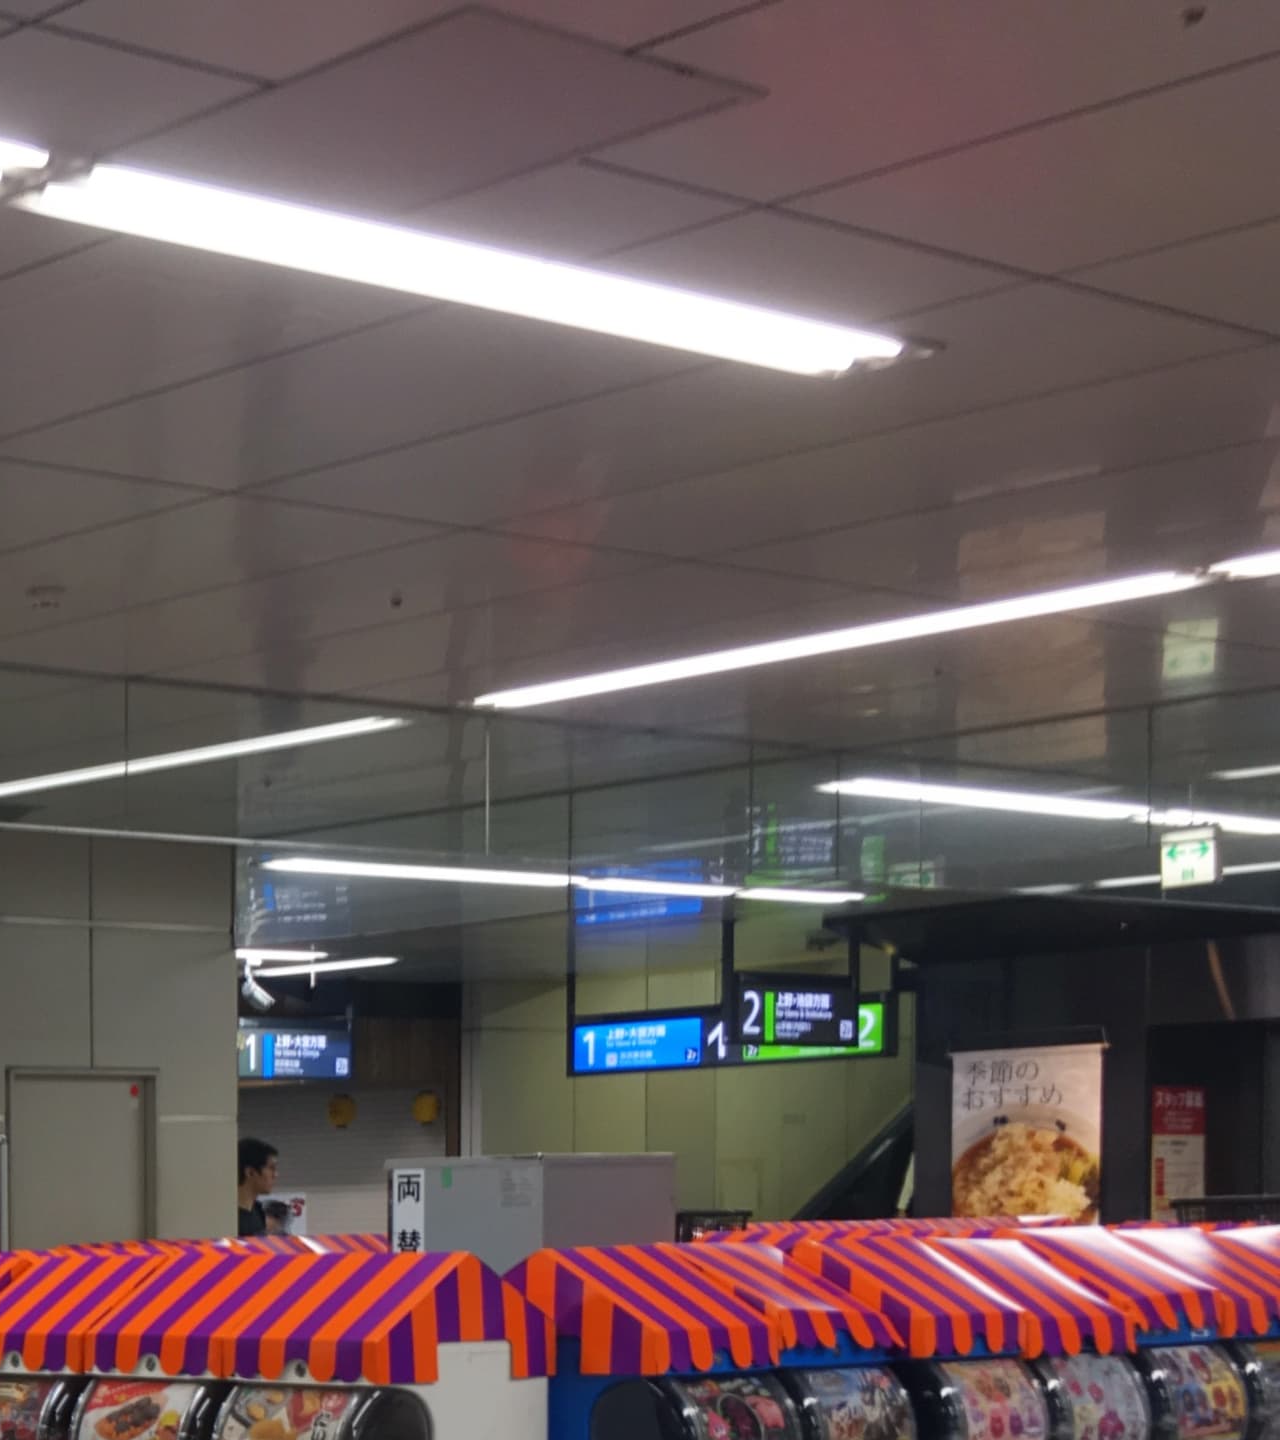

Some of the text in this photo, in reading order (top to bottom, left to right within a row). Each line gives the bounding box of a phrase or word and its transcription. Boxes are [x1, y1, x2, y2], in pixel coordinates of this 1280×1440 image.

[742, 990, 761, 1035] 2
[246, 1033, 256, 1072] 1
[583, 1029, 595, 1067] 1
[967, 1059, 1039, 1085] 季節の
[963, 1084, 1064, 1110] おすすめ
